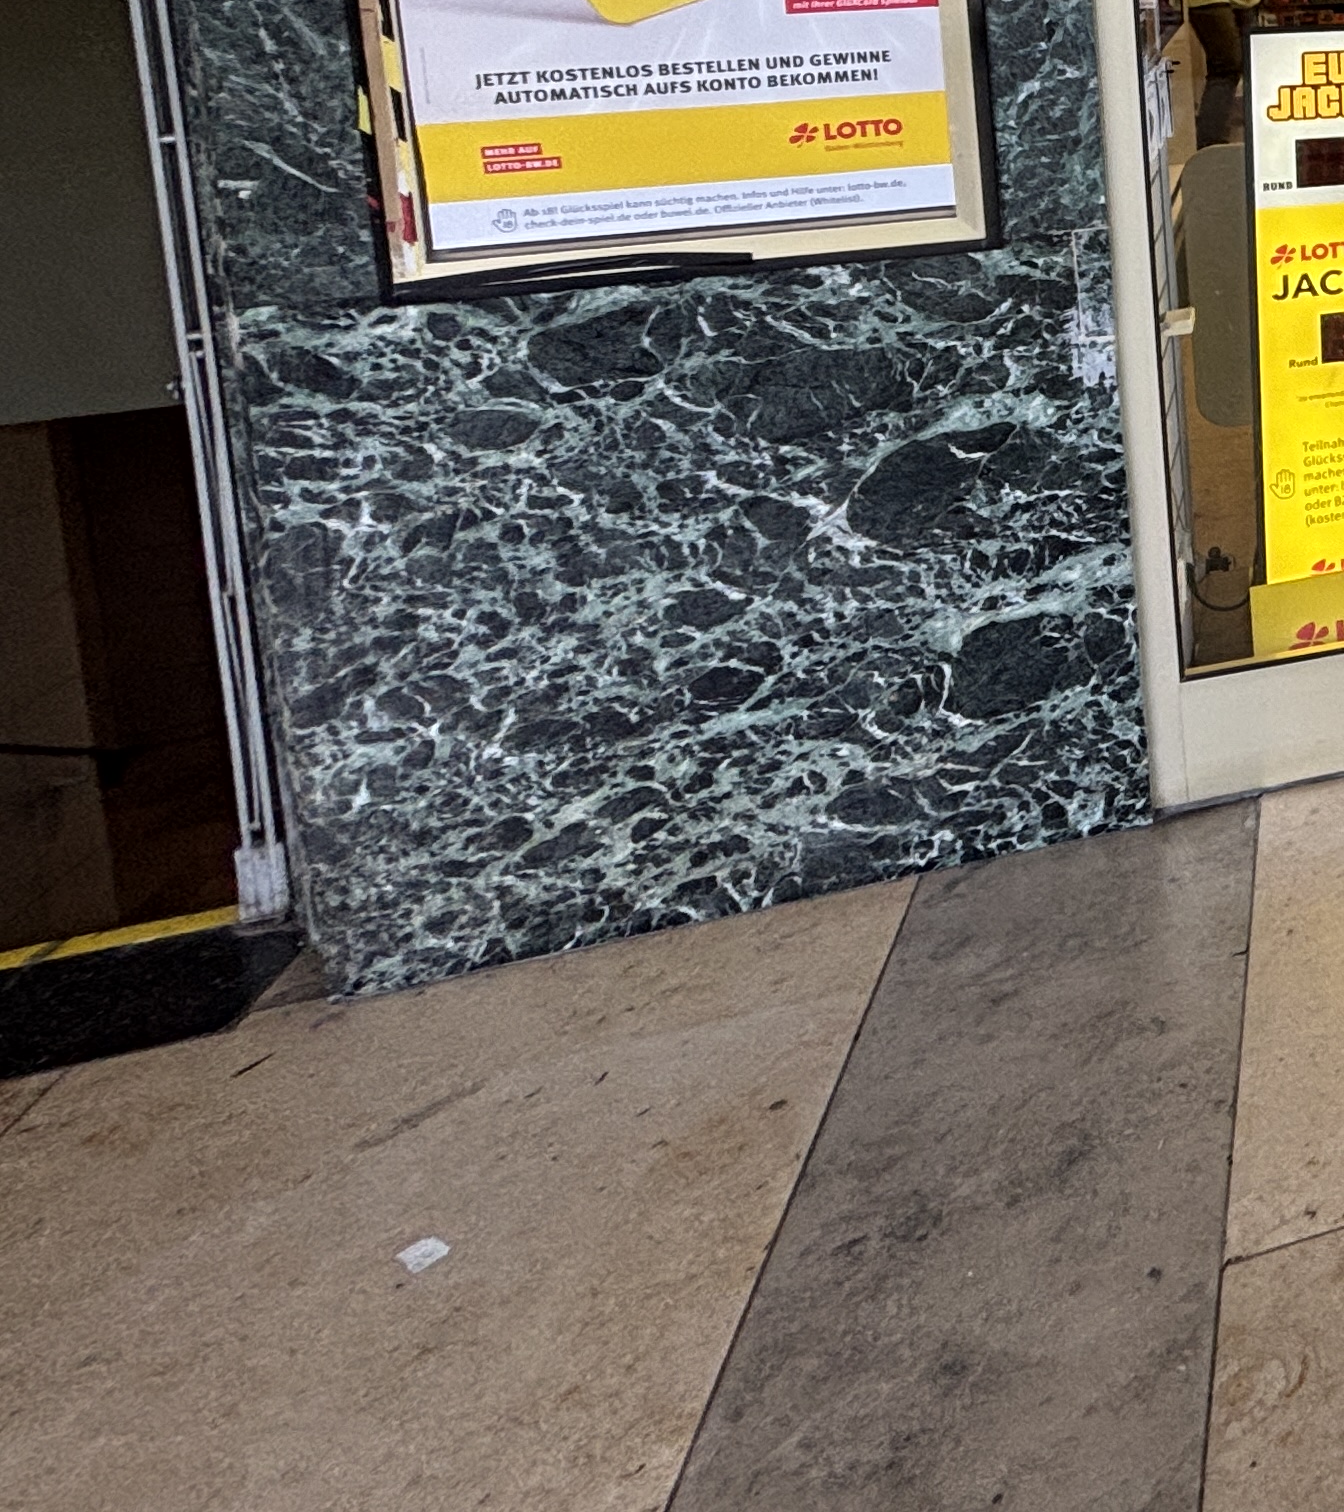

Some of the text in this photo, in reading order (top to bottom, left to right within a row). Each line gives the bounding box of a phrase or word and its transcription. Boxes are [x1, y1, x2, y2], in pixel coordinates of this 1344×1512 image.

[475, 49, 893, 90] JETZT KOSTENLOS BESTELLEN UND GEWINNE
[493, 67, 880, 105] AUTOMATISCH AUFS KONTO BEKOMMEN!
[823, 118, 904, 141] LOTTO
[484, 146, 516, 157] MEHR
[1262, 180, 1293, 193] RUND
[560, 201, 624, 215] Glücksspiel
[626, 199, 652, 209] kann
[654, 195, 694, 208] süchtig
[770, 187, 789, 198] und
[1288, 356, 1319, 369] Rund
[1304, 483, 1340, 498] unter:
[1304, 499, 1332, 512] oder
